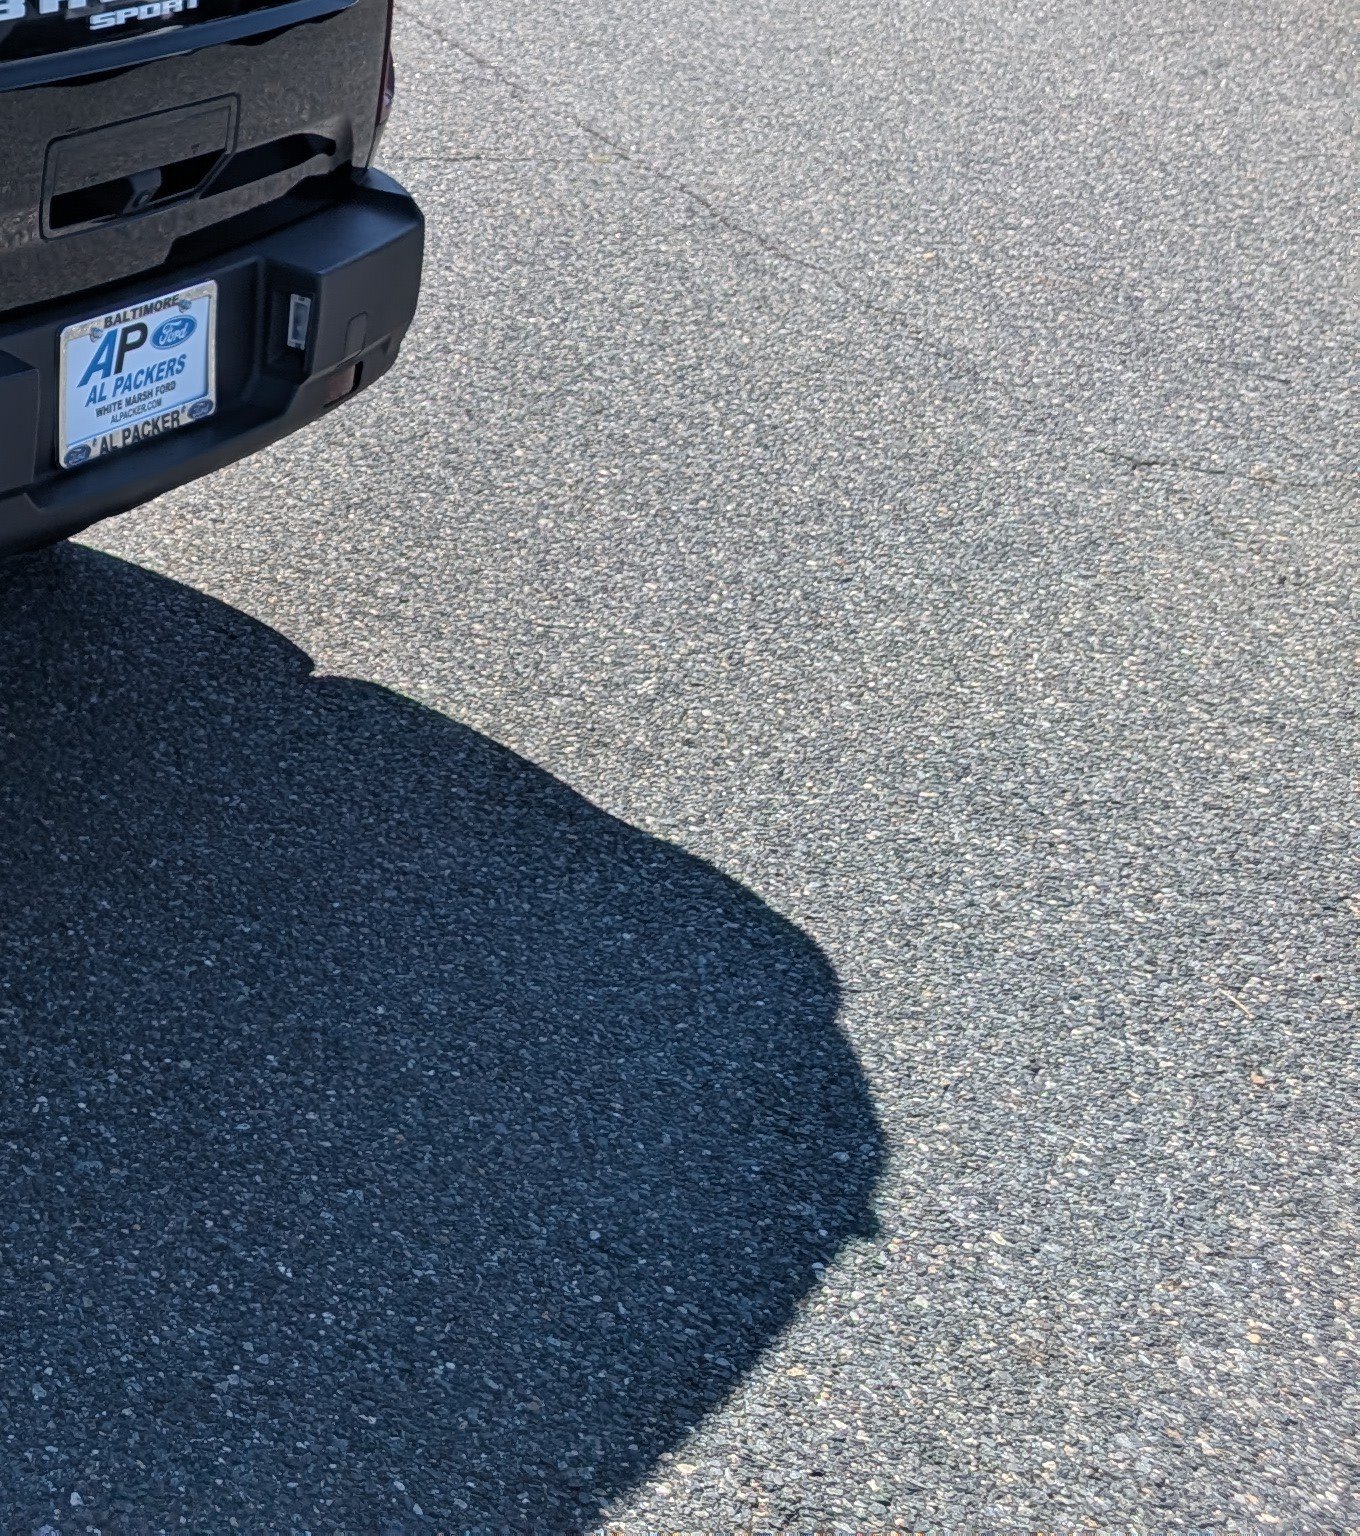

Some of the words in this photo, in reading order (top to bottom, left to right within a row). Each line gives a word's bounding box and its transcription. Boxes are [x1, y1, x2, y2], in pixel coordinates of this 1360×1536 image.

[104, 294, 179, 329] BALTIMORE
[159, 320, 189, 345] Ford
[77, 322, 148, 388] AP
[84, 382, 107, 407] AL
[112, 353, 187, 398] PACKERS
[95, 399, 122, 417] WHITE
[125, 388, 153, 407] MARSH
[155, 380, 176, 396] FORD
[110, 397, 162, 424] ALPACKER.COM
